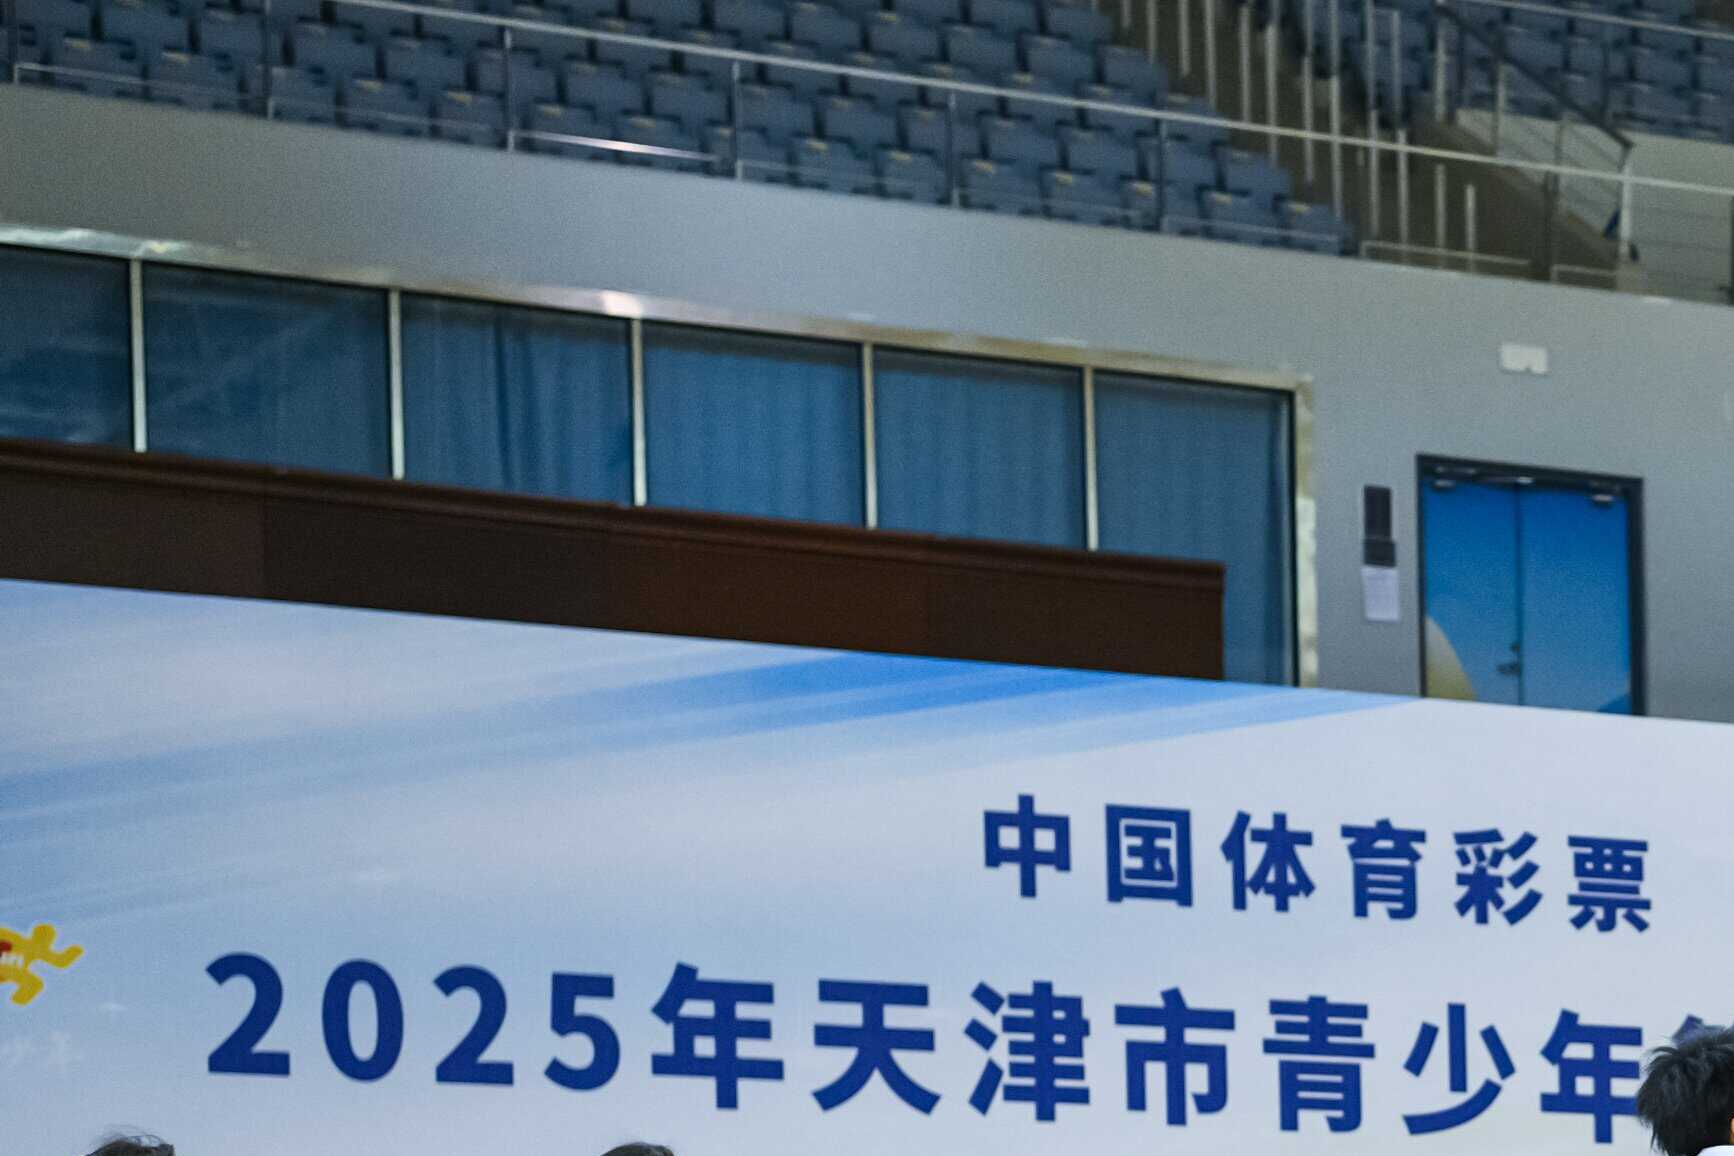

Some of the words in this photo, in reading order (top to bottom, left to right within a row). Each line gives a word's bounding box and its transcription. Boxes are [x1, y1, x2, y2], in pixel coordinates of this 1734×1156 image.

[983, 794, 1653, 933] 中国体育彩票
